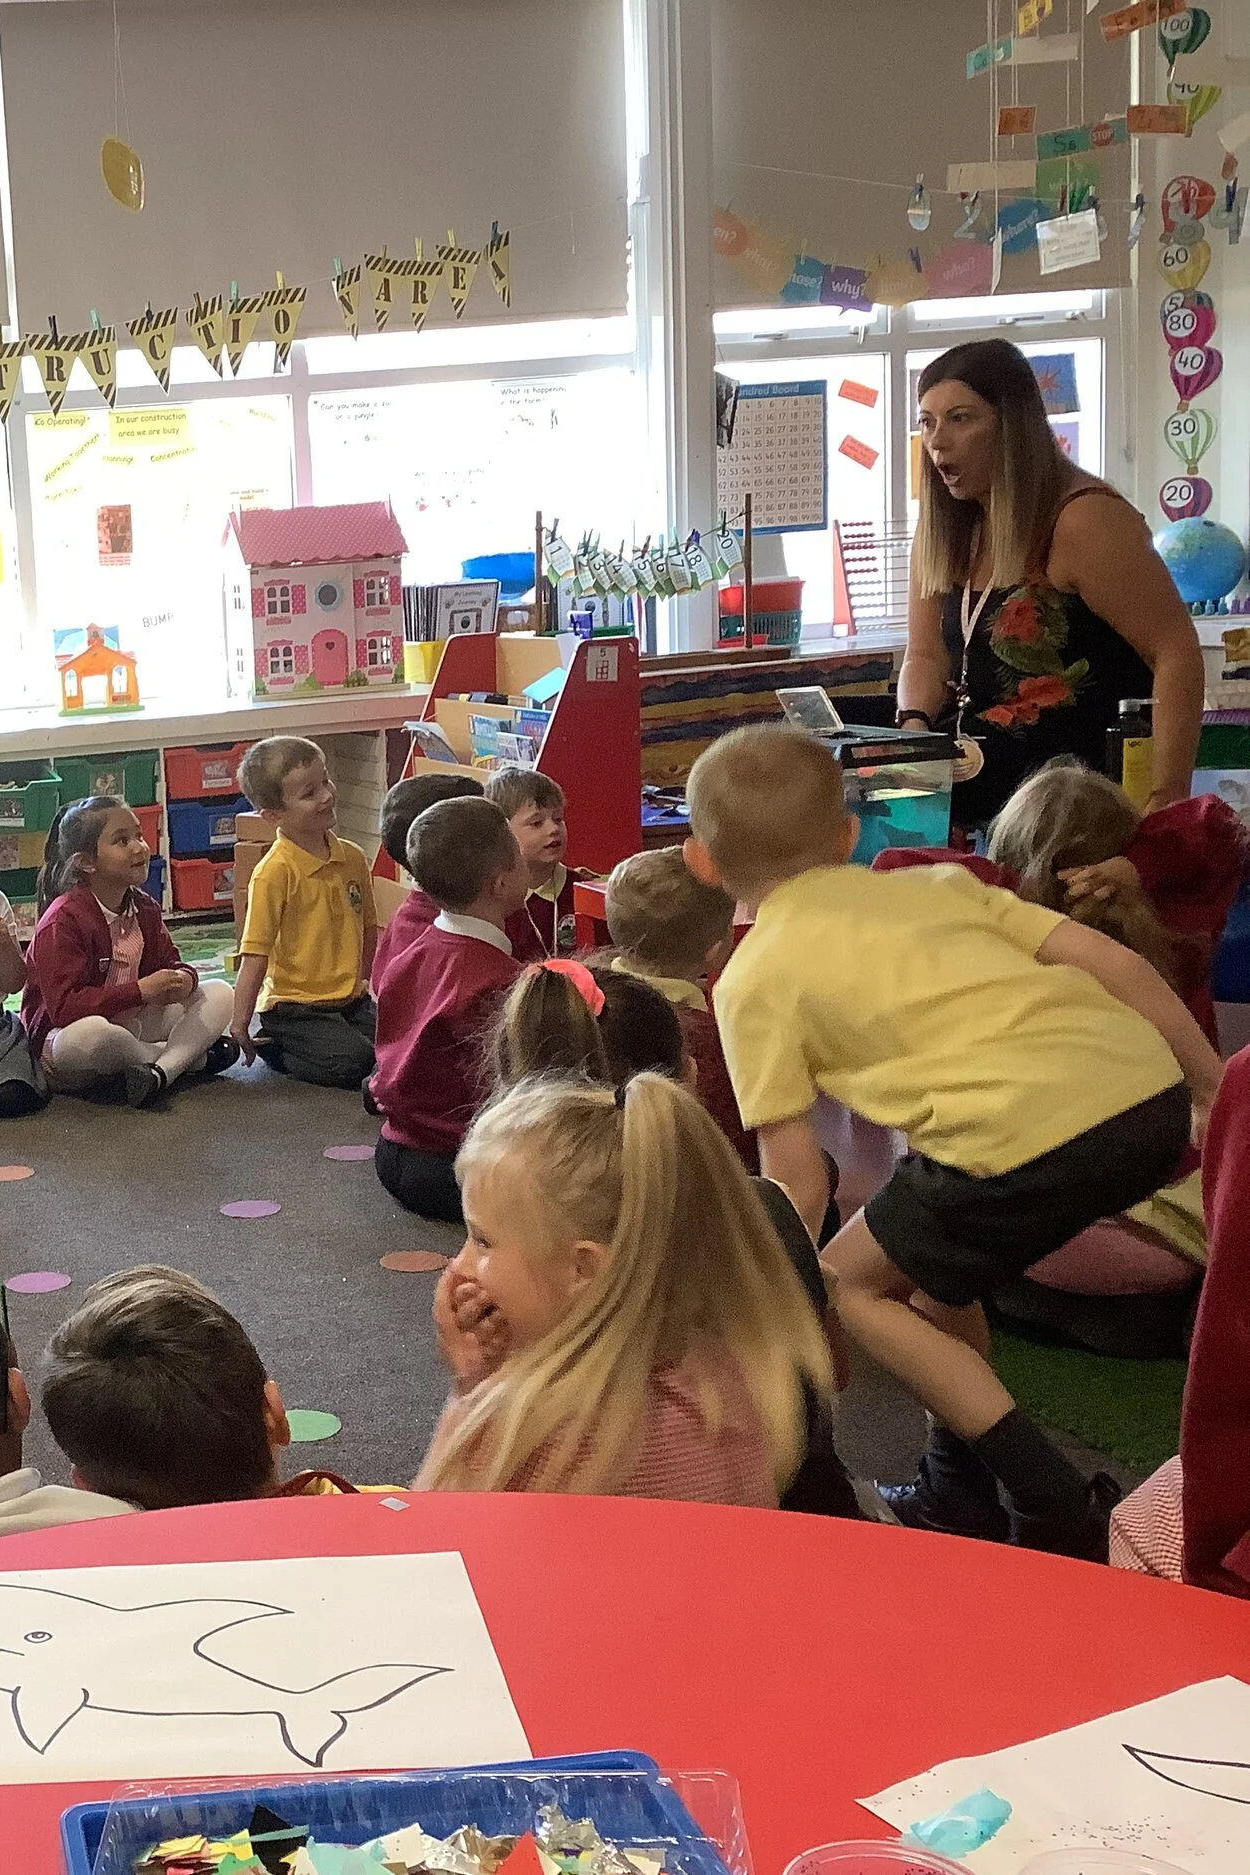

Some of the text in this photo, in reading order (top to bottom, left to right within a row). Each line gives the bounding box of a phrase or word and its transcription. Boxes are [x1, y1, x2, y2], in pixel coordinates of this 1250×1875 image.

[1163, 18, 1190, 32] 100
[1092, 130, 1114, 142] STOP
[1163, 248, 1189, 267] 60
[832, 279, 869, 299] why?
[1169, 313, 1195, 331] 80
[1178, 351, 1204, 369] 40
[500, 388, 521, 396] What
[773, 384, 799, 394] Board
[320, 403, 334, 411] Can
[337, 402, 350, 411] you
[116, 415, 125, 424] In
[141, 413, 187, 423] construction
[741, 415, 751, 423] 14
[754, 414, 762, 422] 15
[765, 413, 775, 421] 16
[789, 412, 798, 420] 18
[801, 411, 810, 419] 19
[118, 429, 135, 437] area
[148, 428, 160, 436] are
[162, 426, 180, 436] busy
[741, 428, 751, 436] 24
[754, 427, 762, 435] 25
[765, 426, 775, 434] 26
[777, 425, 786, 433] 27
[789, 425, 798, 433] 28
[801, 424, 810, 432] 29
[1170, 417, 1196, 436] 30
[741, 441, 751, 449] 34
[754, 440, 762, 448] 35
[765, 439, 775, 448] 36
[777, 438, 786, 446] 37
[789, 437, 798, 446] 38
[801, 436, 810, 445] 39
[718, 455, 727, 463] 42
[729, 454, 739, 463] 43
[741, 454, 751, 462] 44
[754, 452, 762, 461] 45
[765, 452, 775, 460] 46
[777, 451, 786, 459] 47
[789, 450, 798, 459] 48
[801, 449, 810, 457] 49
[718, 468, 727, 476] 52
[729, 467, 739, 476] 53
[754, 466, 762, 474] 55
[777, 464, 786, 472] 57
[789, 463, 798, 471] 58
[801, 462, 810, 470] 59
[718, 481, 727, 489] 62
[729, 480, 739, 489] 63
[741, 479, 751, 487] 64
[754, 479, 762, 487] 65
[765, 478, 775, 486] 66
[777, 477, 786, 485] 67
[789, 476, 798, 484] 68
[718, 494, 727, 502] 72
[729, 493, 739, 502] 73
[754, 491, 762, 500] 75
[765, 490, 775, 499] 76
[777, 490, 786, 498] 77
[789, 489, 798, 497] 78
[1166, 485, 1191, 502] 20
[717, 529, 734, 550] 20
[669, 551, 685, 568] 17
[686, 547, 702, 567] 18
[607, 555, 624, 574] 14
[600, 647, 606, 657] 5
